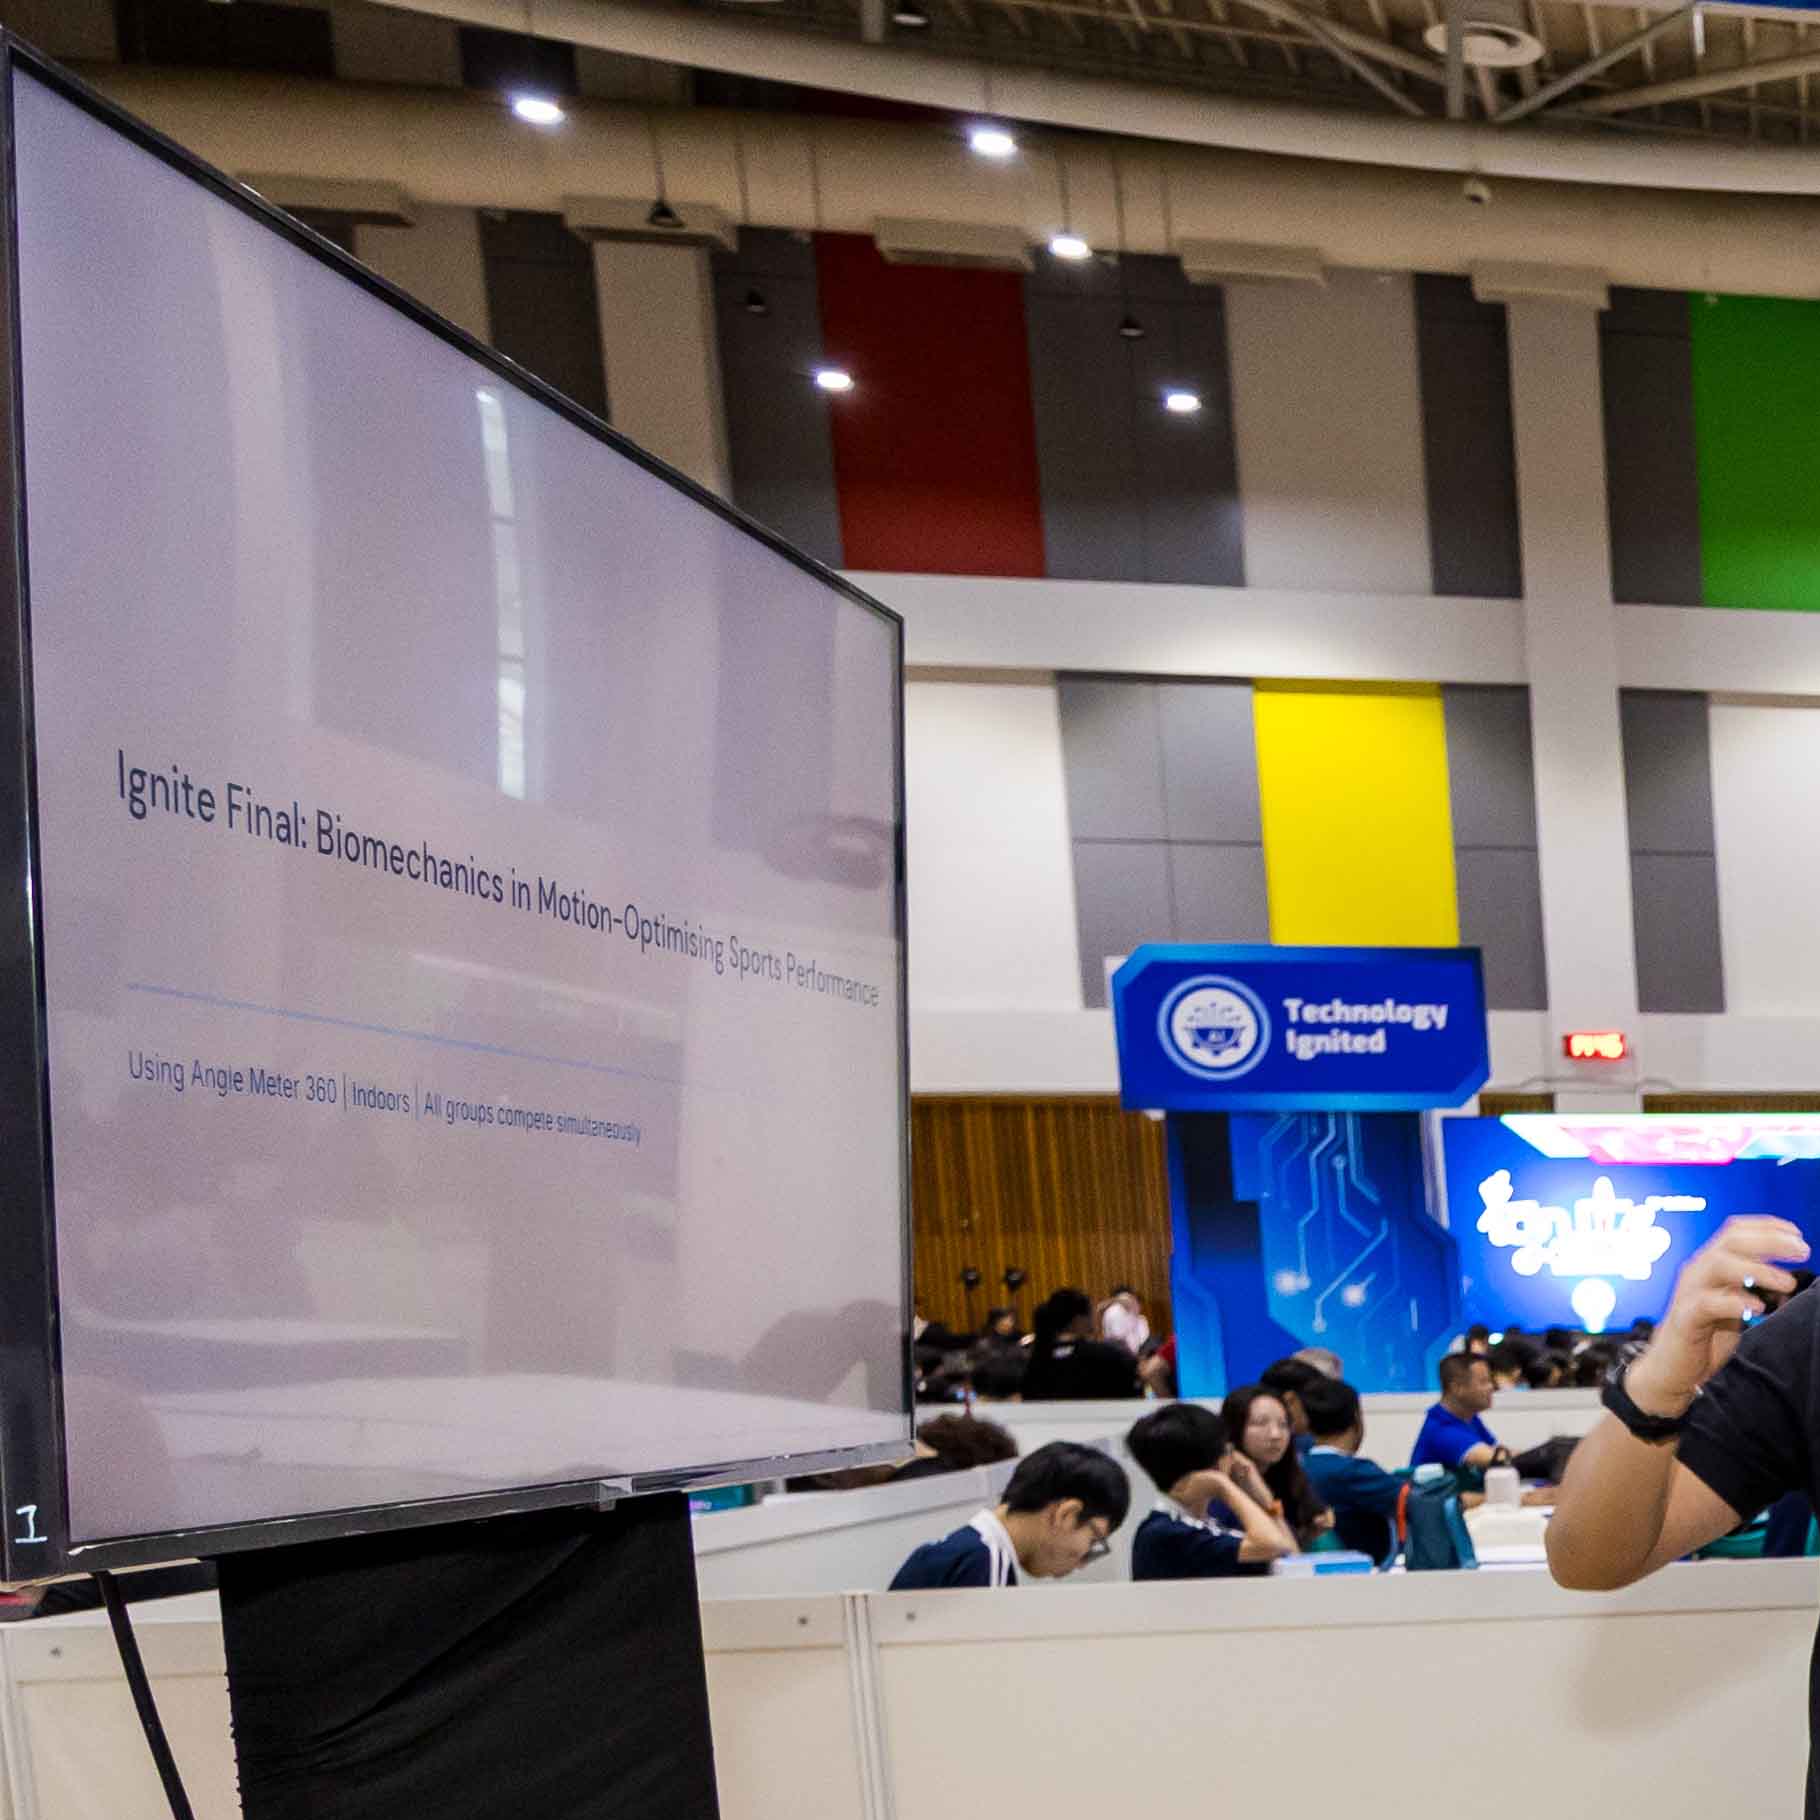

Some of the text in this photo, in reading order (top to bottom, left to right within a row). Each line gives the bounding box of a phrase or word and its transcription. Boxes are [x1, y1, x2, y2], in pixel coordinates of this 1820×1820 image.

[117, 749, 880, 1007] Ignite Final: Biomechanics in Motion-Optimising Sports Performance
[1283, 998, 1448, 1030] Technology
[1285, 1028, 1387, 1060] Ignited
[128, 1052, 185, 1092] Using
[191, 1060, 243, 1097] Angle
[250, 1068, 300, 1099] Meter
[305, 1075, 337, 1104] 360
[352, 1083, 411, 1113] Indoors
[424, 1092, 442, 1117] All
[446, 1098, 494, 1129] groups
[497, 1105, 553, 1133] compete
[556, 1113, 641, 1145] simultaneously
